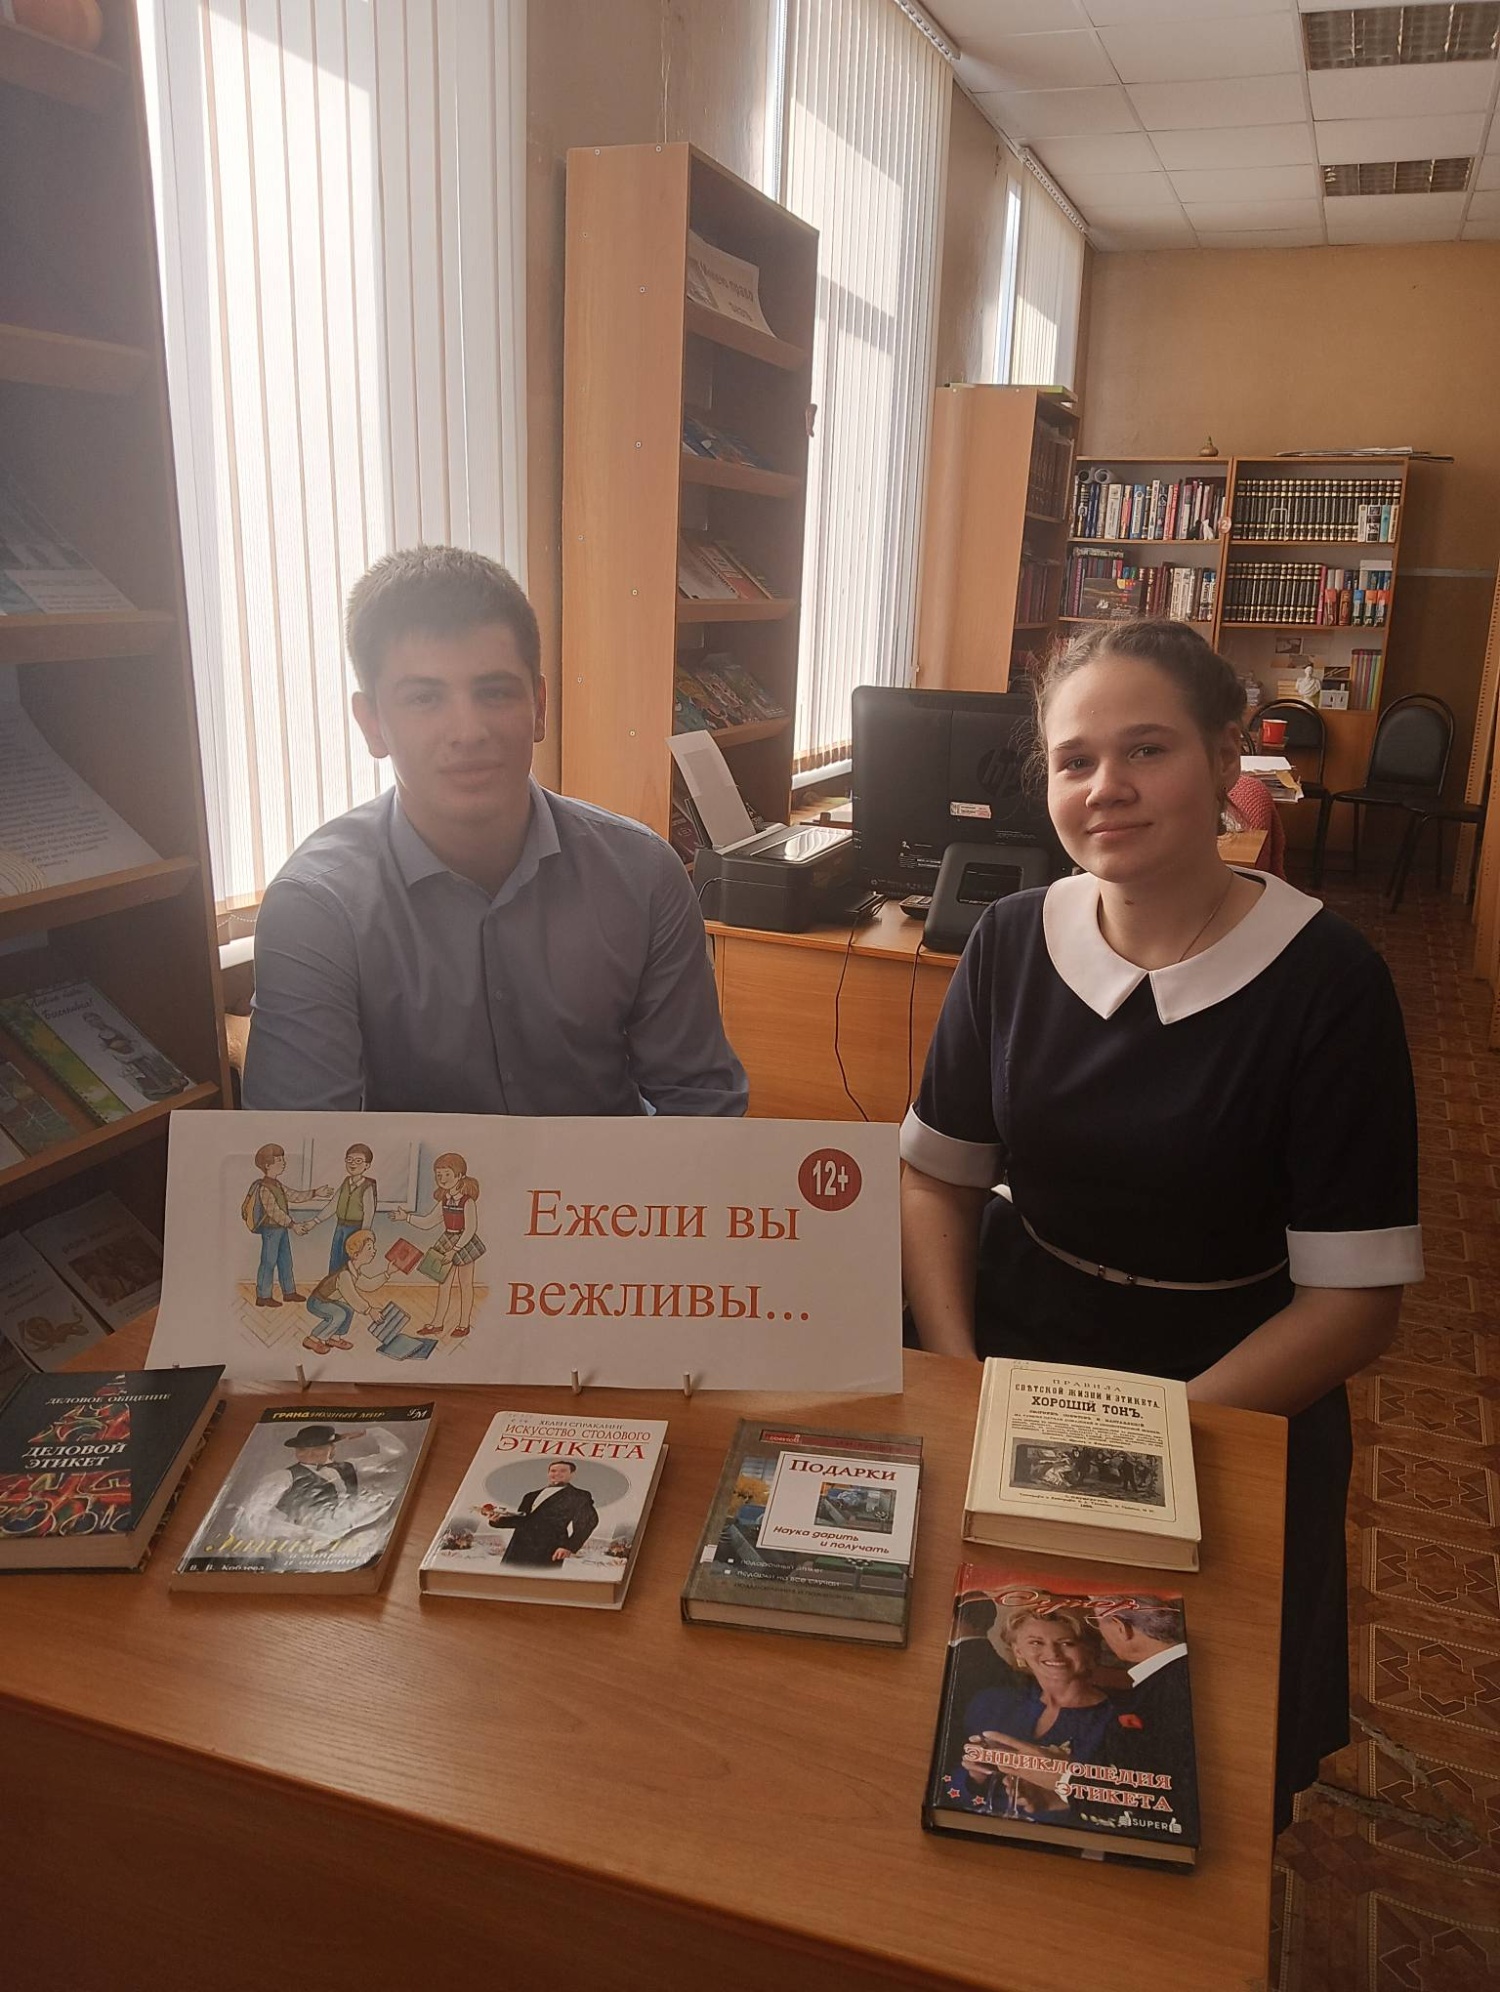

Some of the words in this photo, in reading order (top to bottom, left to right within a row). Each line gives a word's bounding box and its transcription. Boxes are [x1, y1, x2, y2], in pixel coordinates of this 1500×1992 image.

[812, 1159, 849, 1196] 12+
[524, 1189, 708, 1238] Ежели
[726, 1206, 801, 1240] вы
[505, 1281, 810, 1321] вежливы...
[1053, 1379, 1121, 1392] ПРАВИЛА
[45, 1396, 102, 1405] ДЕЛОВОЕ
[107, 1393, 171, 1402] ОБЩЕНИЕ
[1069, 1389, 1102, 1400] ЖИЗНИ
[505, 1424, 576, 1437] ИСКУССТВО
[581, 1431, 651, 1441] СТОЛОВОГО
[22, 1442, 127, 1458] ДЕЛОВОЙ
[495, 1435, 646, 1459] ЭТИКЕТА
[25, 1456, 110, 1469] ЭТИКЕТ
[773, 1525, 810, 1536] Наука
[811, 1530, 859, 1542] дарить
[829, 1541, 890, 1554] получать
[965, 1747, 1173, 1791] ЭНЦИКЛОПЕДИЯ
[1055, 1782, 1173, 1813] ЭТИКЕТА
[1132, 1817, 1169, 1831] SUPER
